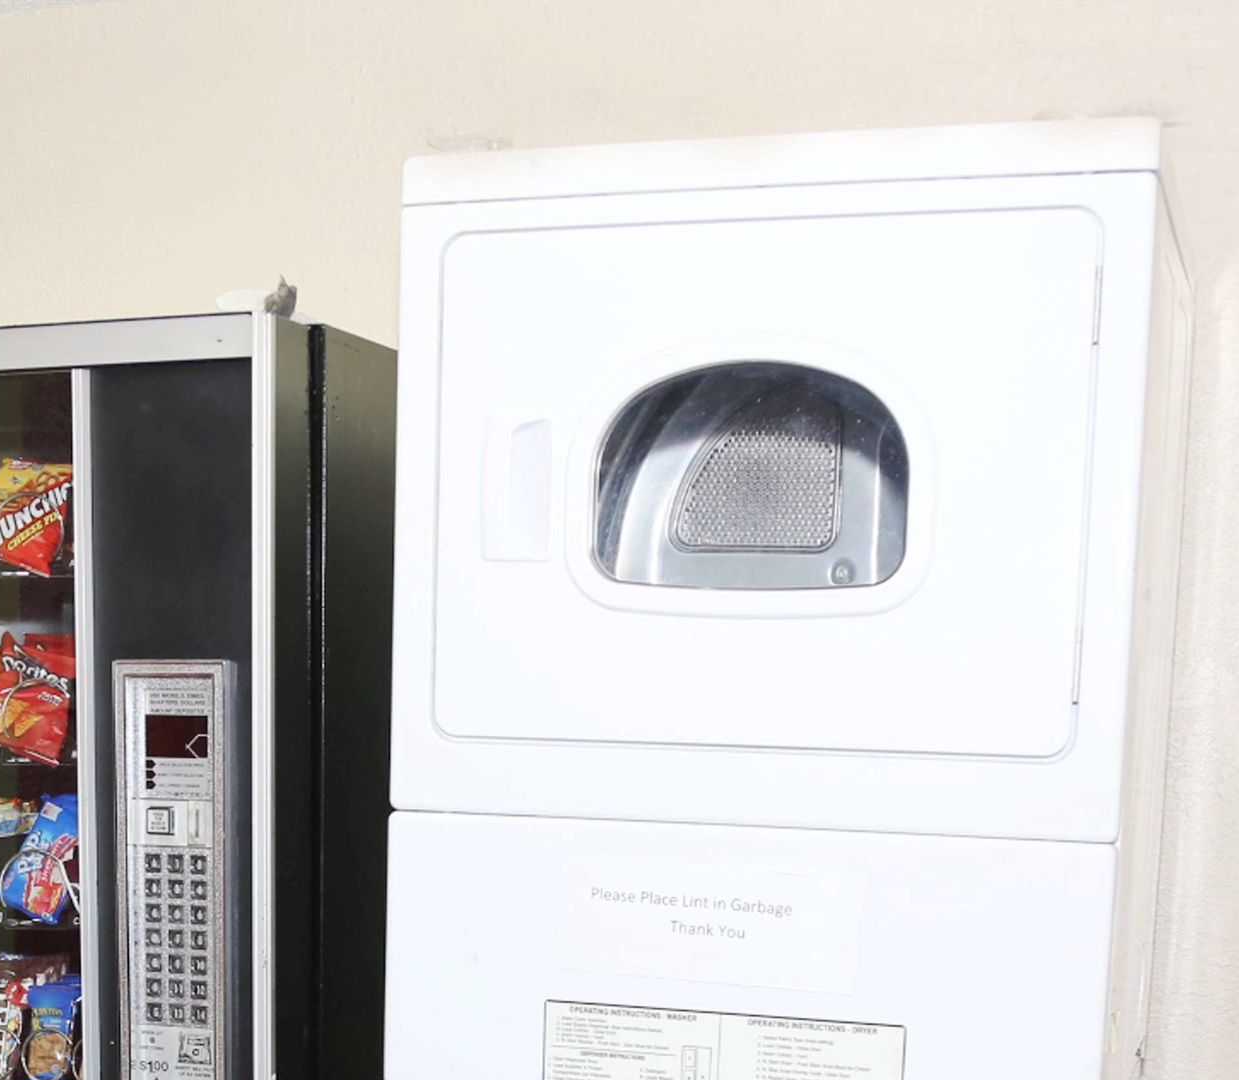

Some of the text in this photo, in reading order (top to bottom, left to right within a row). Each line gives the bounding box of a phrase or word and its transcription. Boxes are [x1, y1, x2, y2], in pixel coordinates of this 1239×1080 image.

[2, 656, 70, 694] Doritos
[590, 886, 794, 919] Please Place Lint in Garbage
[669, 919, 746, 940] Thank You
[569, 1006, 697, 1022] OPERATING INSTRUCTIONS WASHER
[747, 1018, 879, 1035] OPERATING INSTRUCTIONS DRYER
